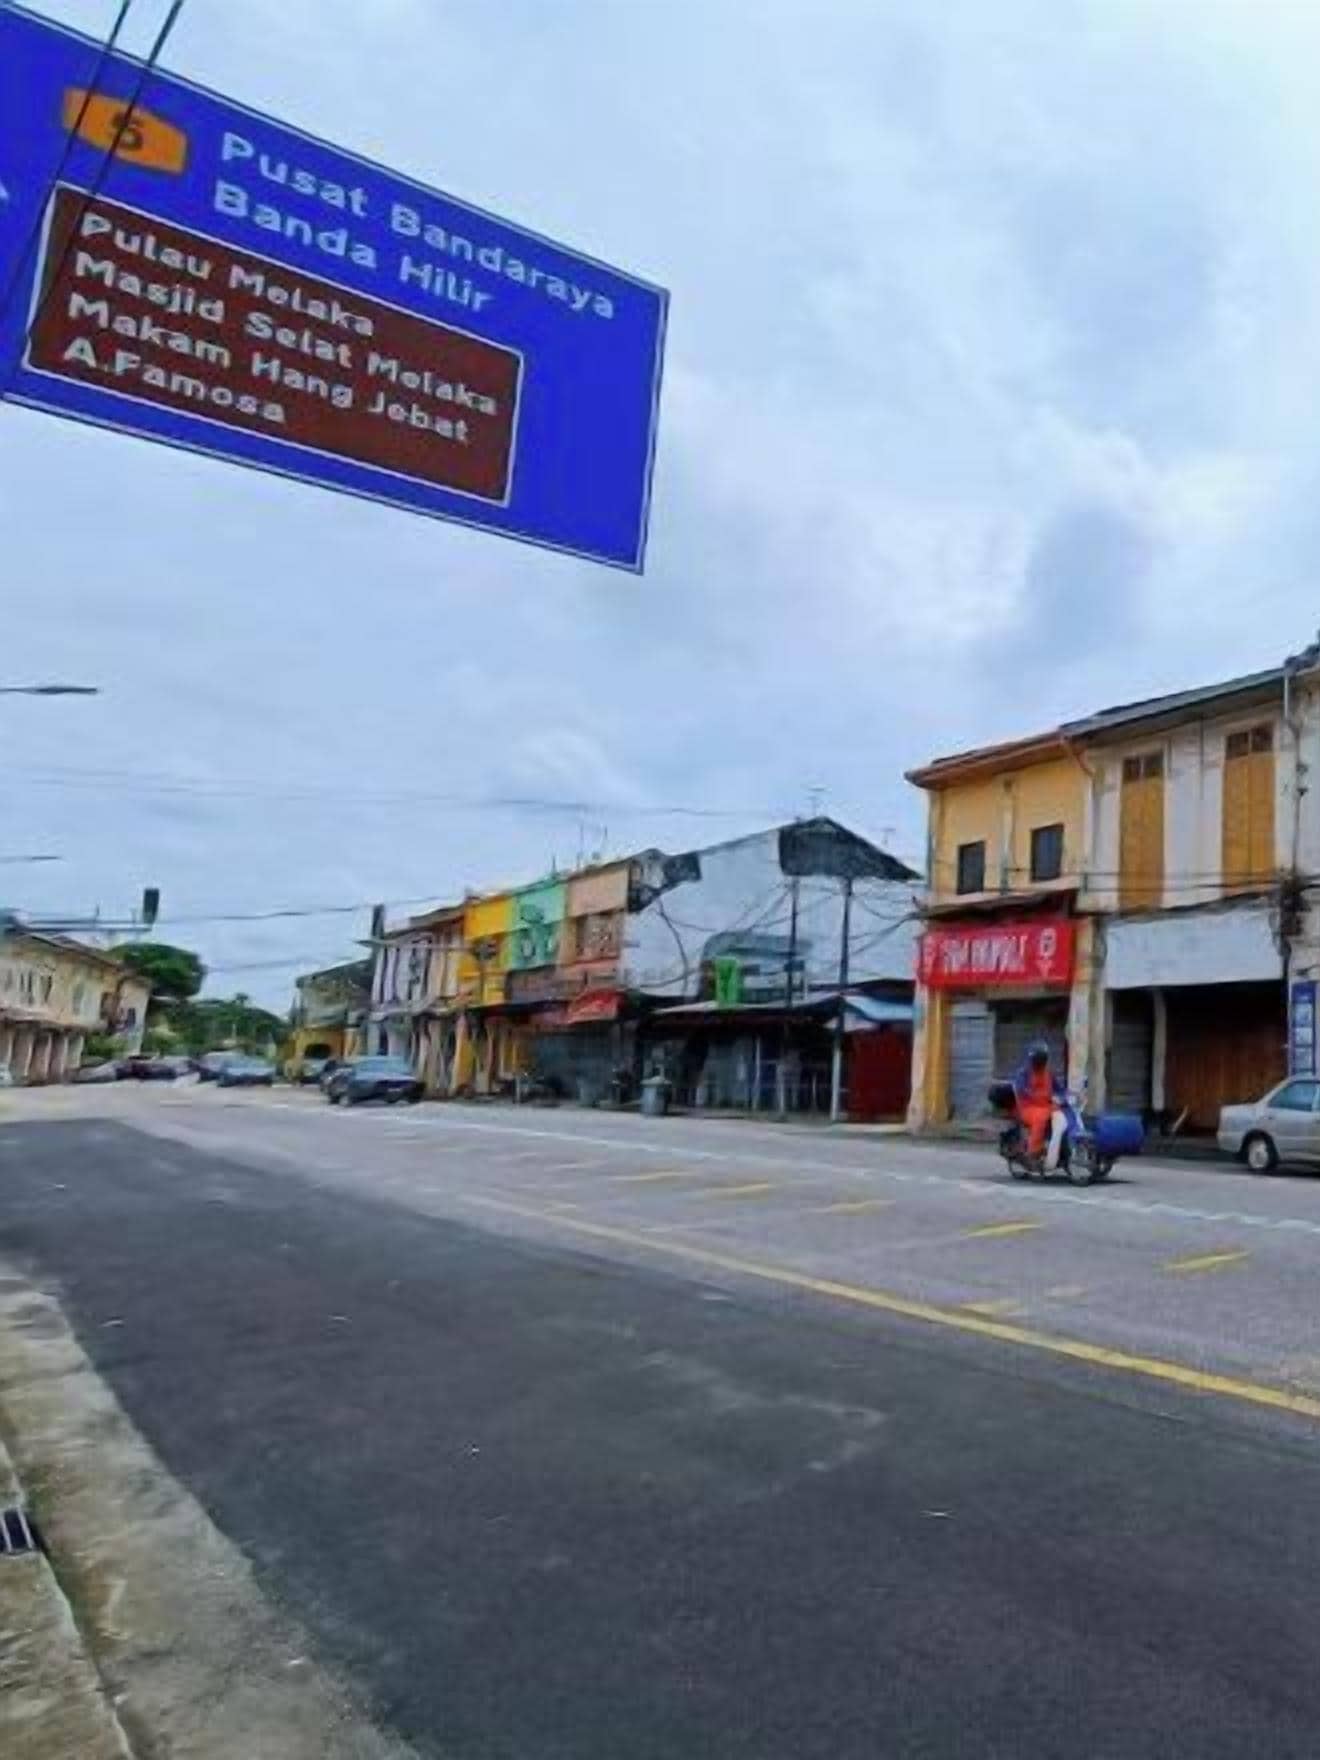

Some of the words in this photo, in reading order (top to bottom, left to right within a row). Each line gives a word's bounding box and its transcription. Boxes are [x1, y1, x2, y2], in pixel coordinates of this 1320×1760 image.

[81, 212, 212, 280] Pulau
[229, 264, 374, 337] Melaka
[214, 180, 378, 269] Banda
[399, 255, 495, 313] Hilir
[221, 132, 368, 217] Pusat
[391, 203, 615, 320] Bandaraya
[63, 337, 285, 424] A.Famosa
[68, 292, 231, 368] Makam
[251, 352, 353, 409] Hang
[367, 391, 469, 442] Jebat
[75, 251, 225, 324] Masjid
[245, 311, 352, 369] Selat
[367, 352, 497, 416] Melaka
